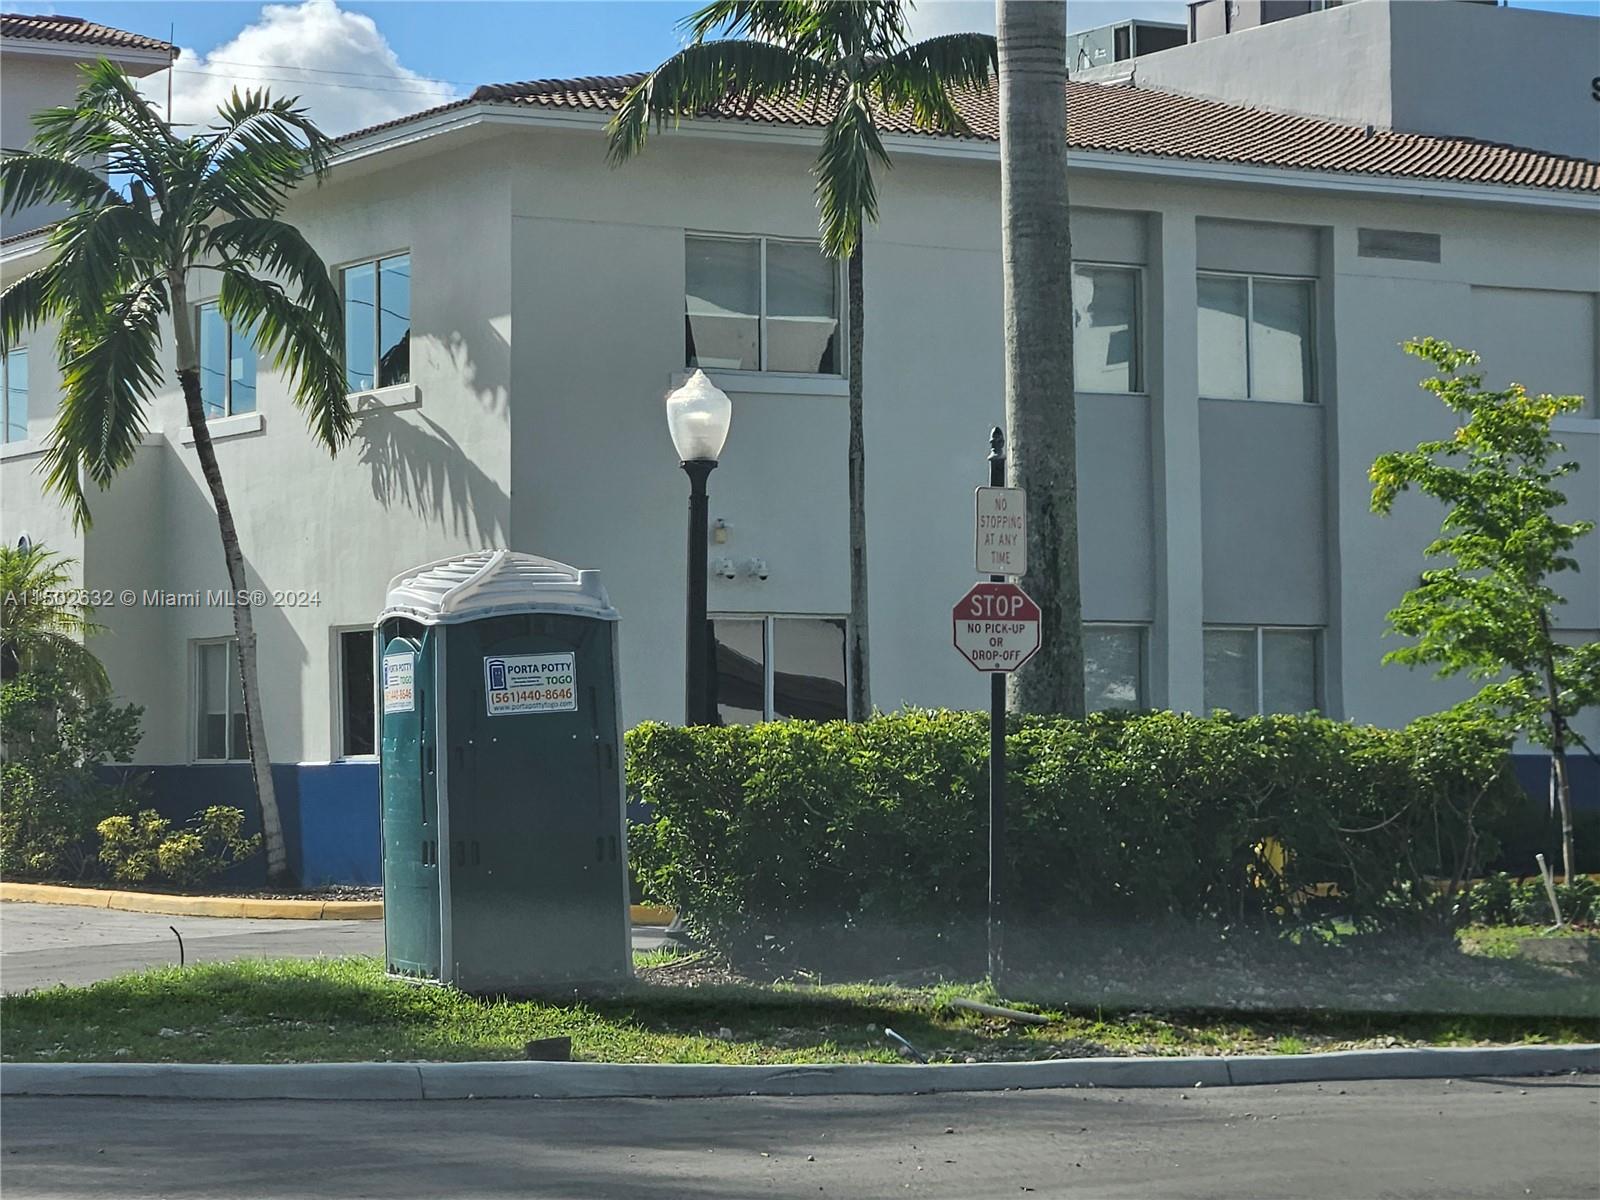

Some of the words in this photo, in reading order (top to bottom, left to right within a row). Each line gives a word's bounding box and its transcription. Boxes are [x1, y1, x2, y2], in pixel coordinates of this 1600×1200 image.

[994, 498, 1007, 511] NO
[980, 515, 1022, 529] STOPPING
[984, 533, 995, 546] AT
[998, 534, 1018, 546] ANY
[991, 551, 1011, 565] TIME
[970, 594, 1024, 617] STOP
[967, 623, 982, 634] NO
[984, 623, 1026, 634] PICK-UP
[989, 637, 1003, 647] OR
[972, 650, 1021, 661] DROP-OFF
[507, 664, 540, 674] PORTA
[541, 662, 572, 672] POTTY
[545, 675, 572, 685] TOGO
[491, 688, 572, 705] (561)440-8646
